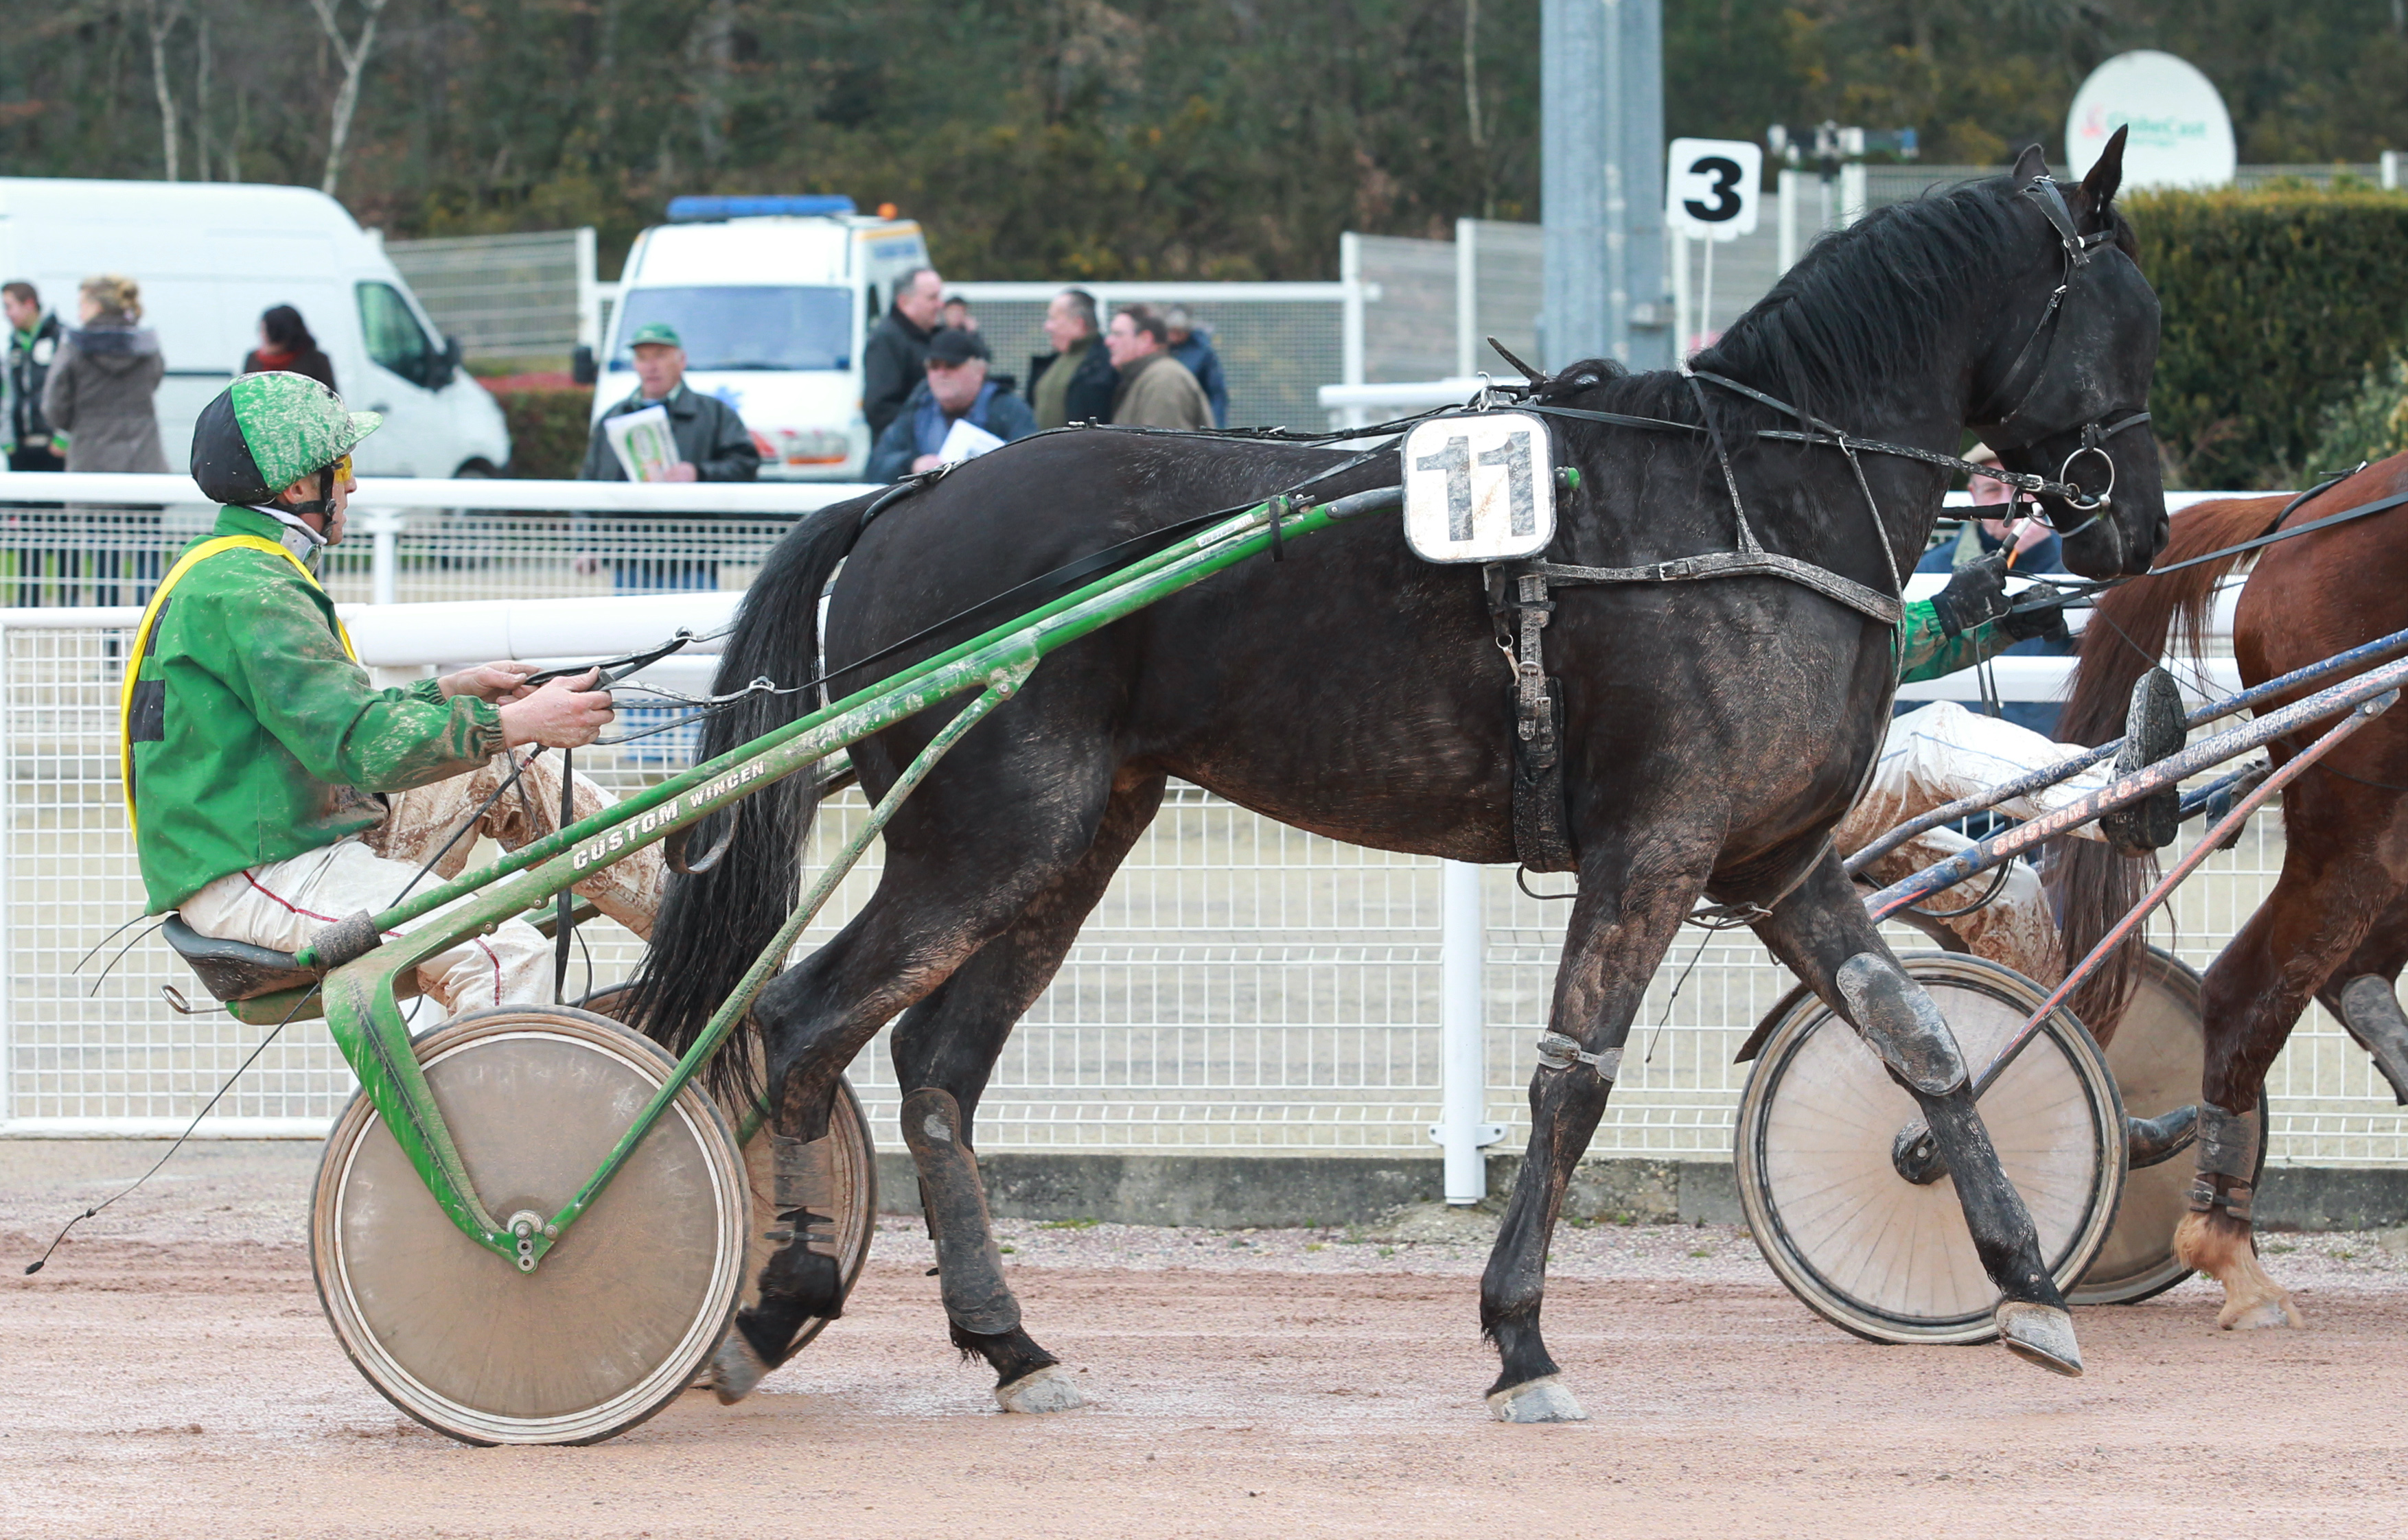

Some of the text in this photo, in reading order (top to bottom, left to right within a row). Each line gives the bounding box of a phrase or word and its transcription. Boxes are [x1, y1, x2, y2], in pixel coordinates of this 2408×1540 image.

[1684, 156, 1742, 222] 3
[1416, 430, 1536, 541] 11
[573, 800, 680, 871] CUSTOM
[1992, 798, 2089, 856] CUSTOM
